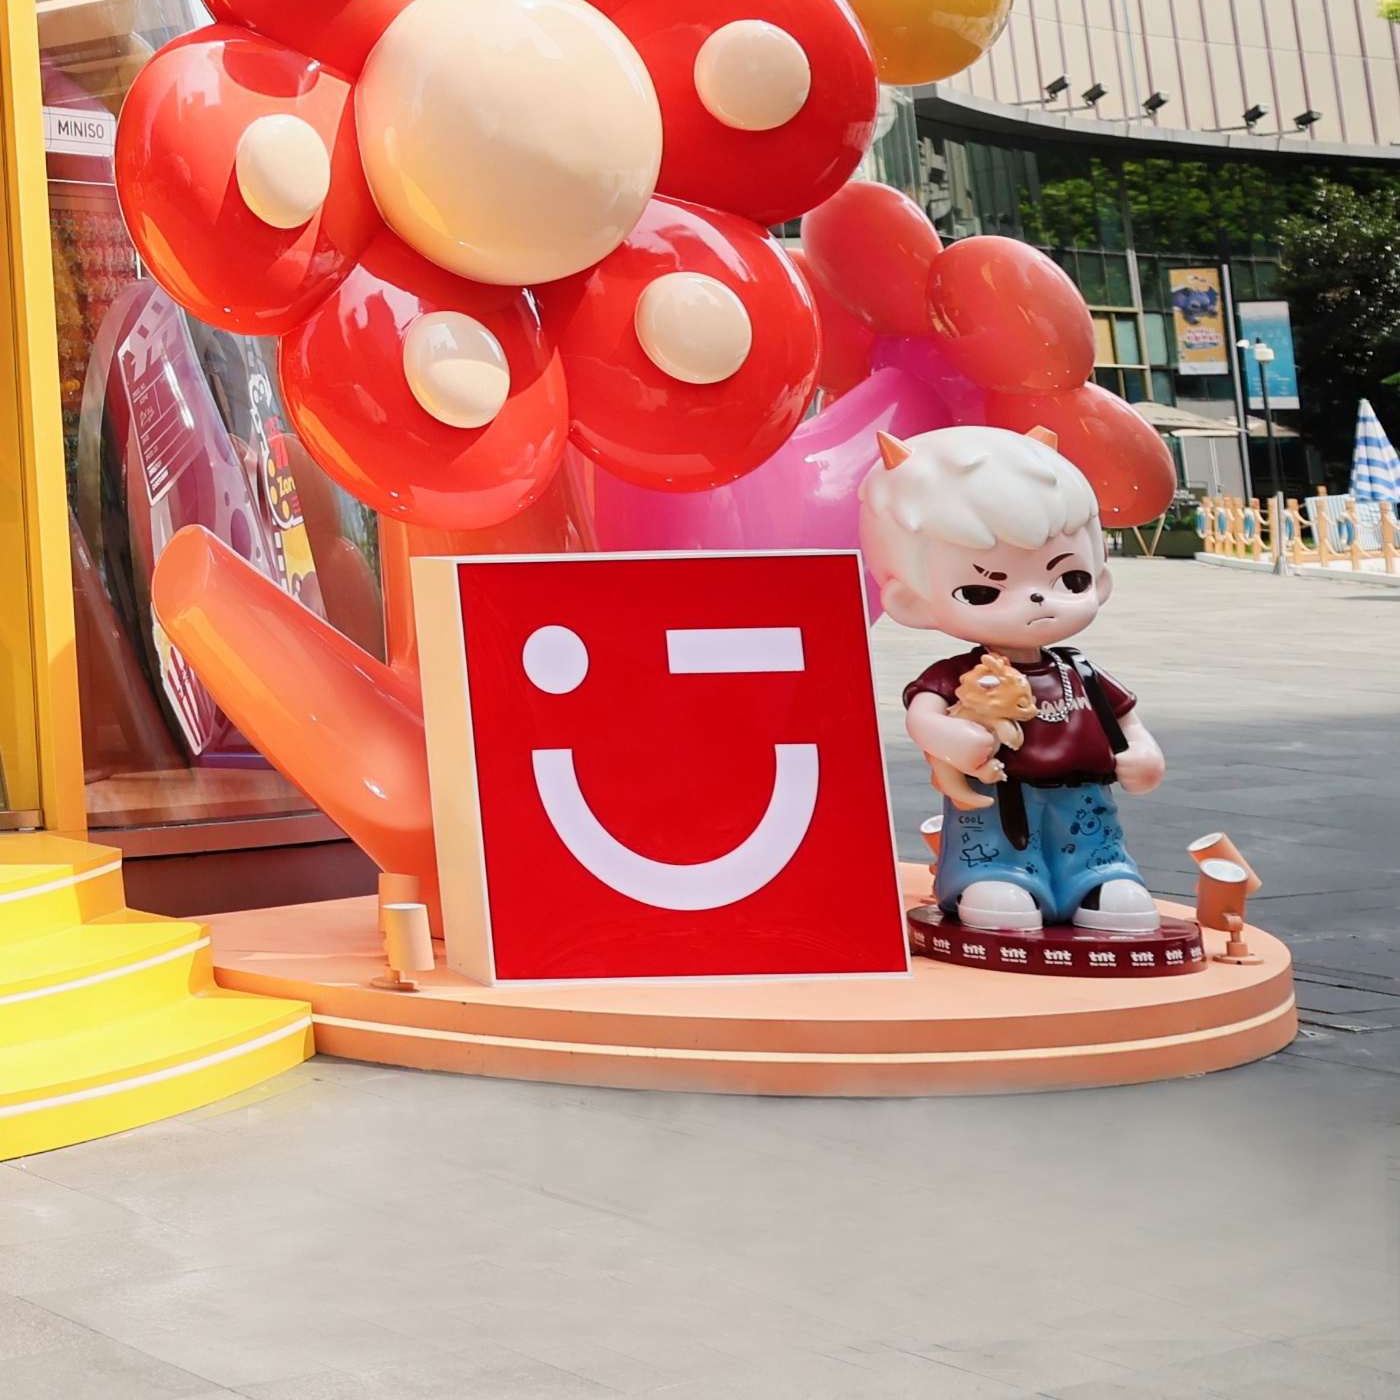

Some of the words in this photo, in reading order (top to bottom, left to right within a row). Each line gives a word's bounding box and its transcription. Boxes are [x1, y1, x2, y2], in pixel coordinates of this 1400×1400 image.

[58, 119, 104, 140] MINISO
[958, 815, 984, 825] COOL
[962, 943, 987, 955] tnt
[1000, 946, 1027, 959] tnt
[1043, 948, 1072, 961] tnt
[1088, 951, 1116, 962] tnt
[1130, 951, 1154, 962] tnt
